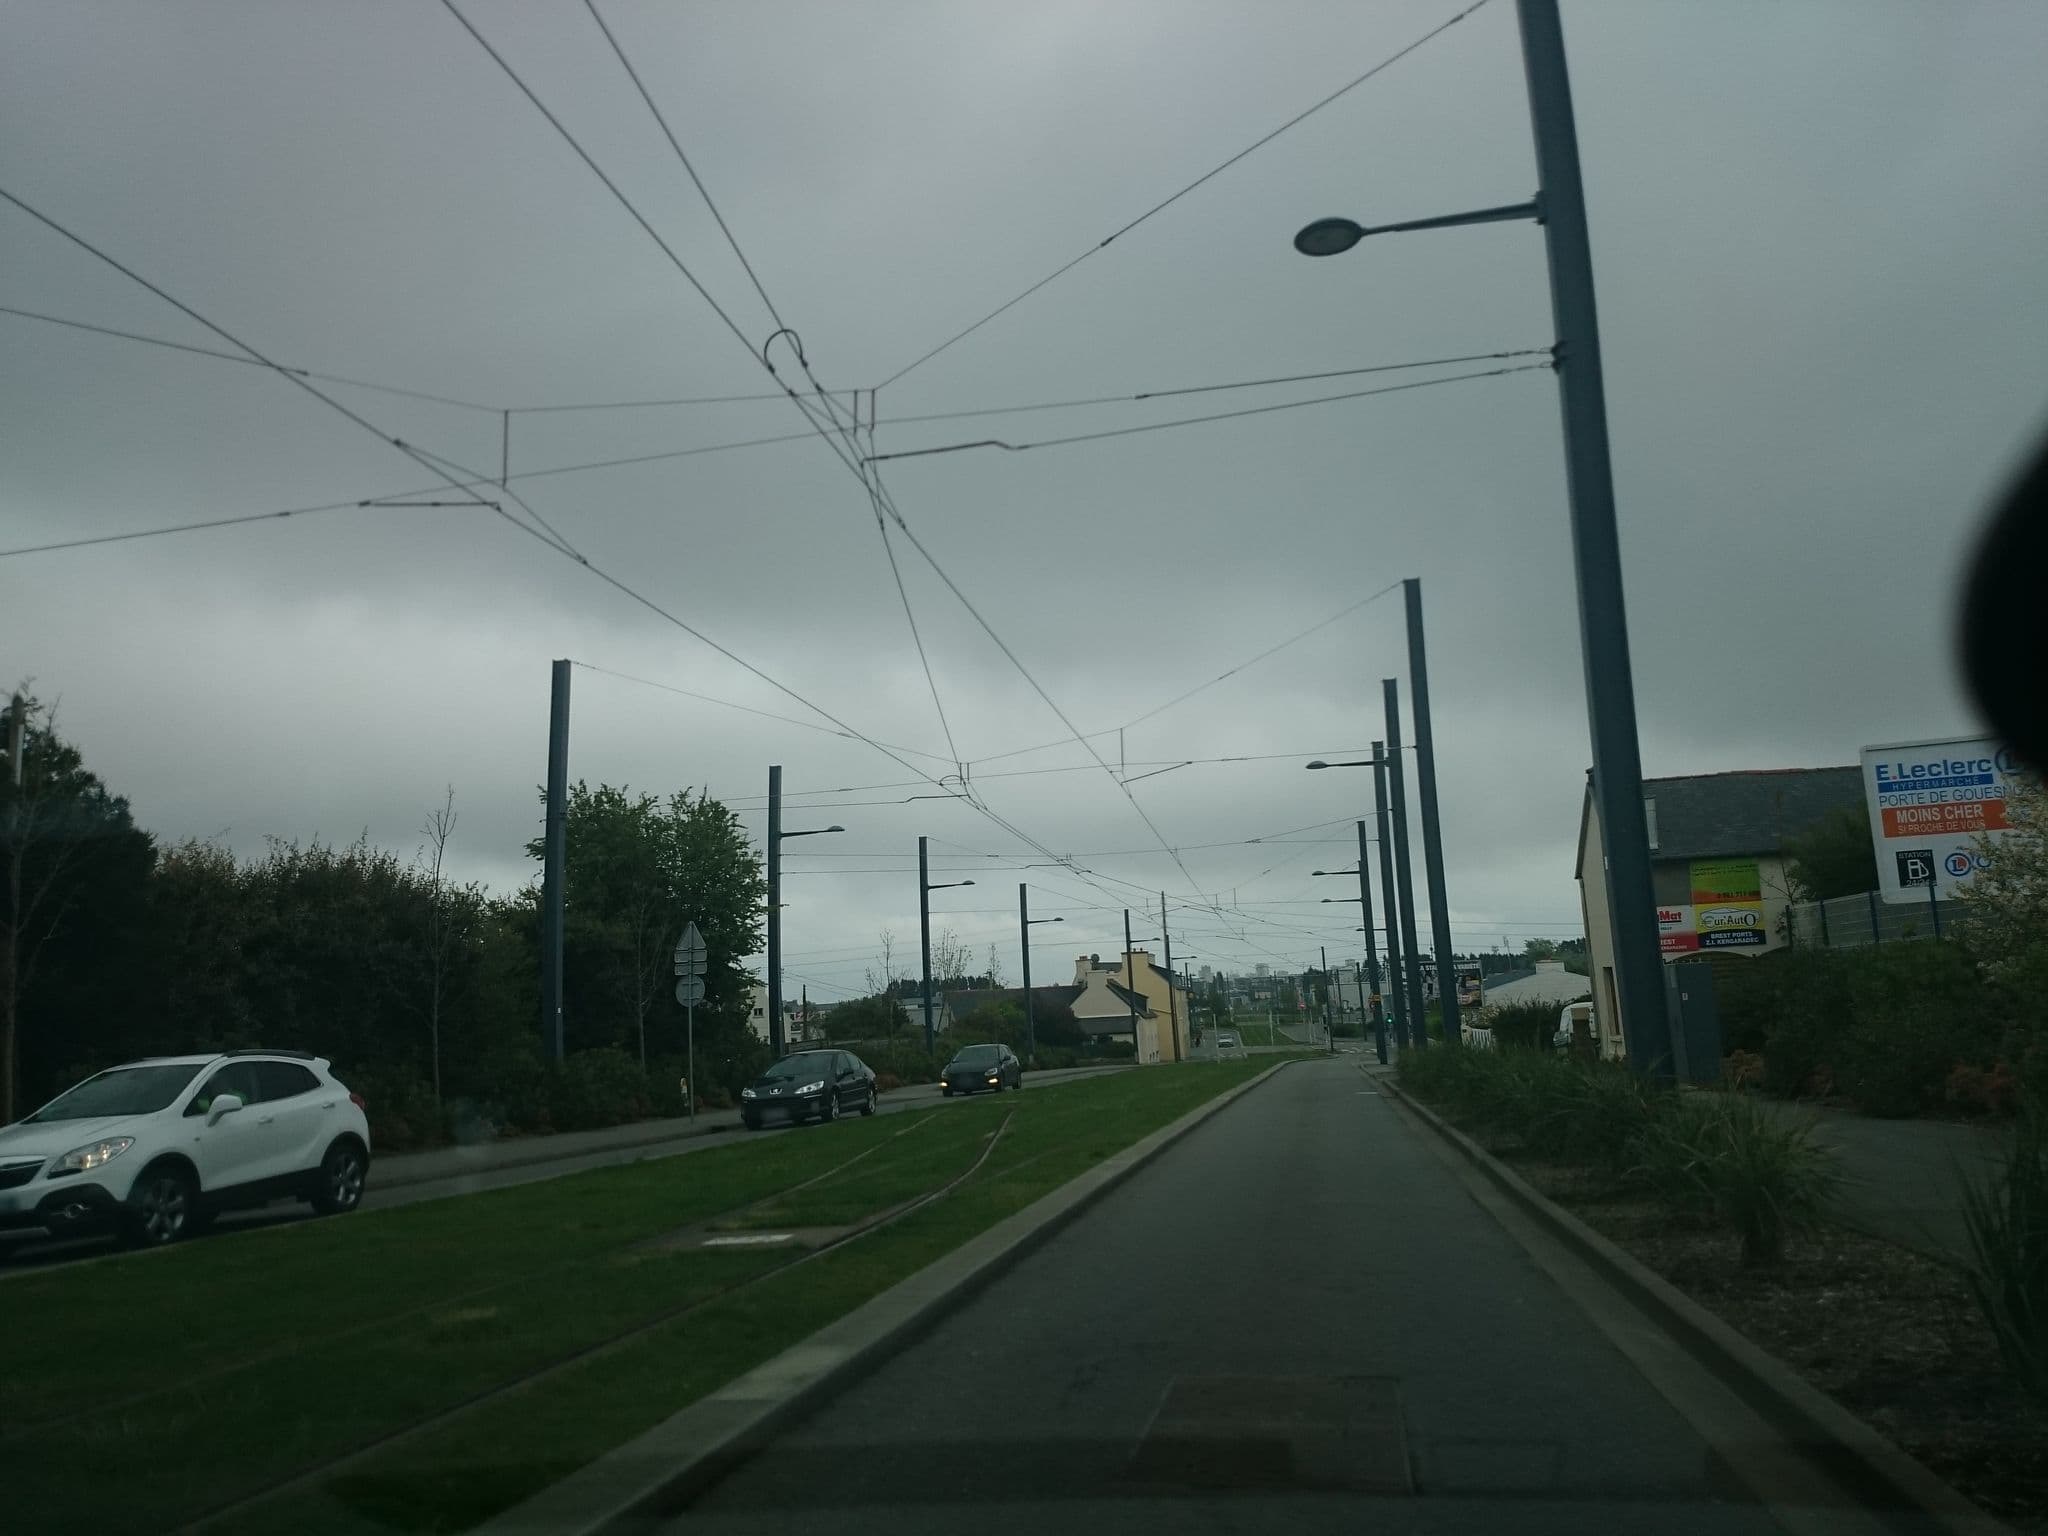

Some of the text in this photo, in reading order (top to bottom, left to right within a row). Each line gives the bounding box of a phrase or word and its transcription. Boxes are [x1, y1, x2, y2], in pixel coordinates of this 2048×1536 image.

[1875, 758, 1992, 781] E.Leclerc
[1879, 792, 1925, 807] PORTE
[1929, 791, 1948, 802] DE
[1896, 804, 1984, 823] MOINS CHER
[1908, 822, 1944, 833] PROCHE
[1946, 821, 1958, 830] DE
[1898, 851, 1931, 859] STATION
